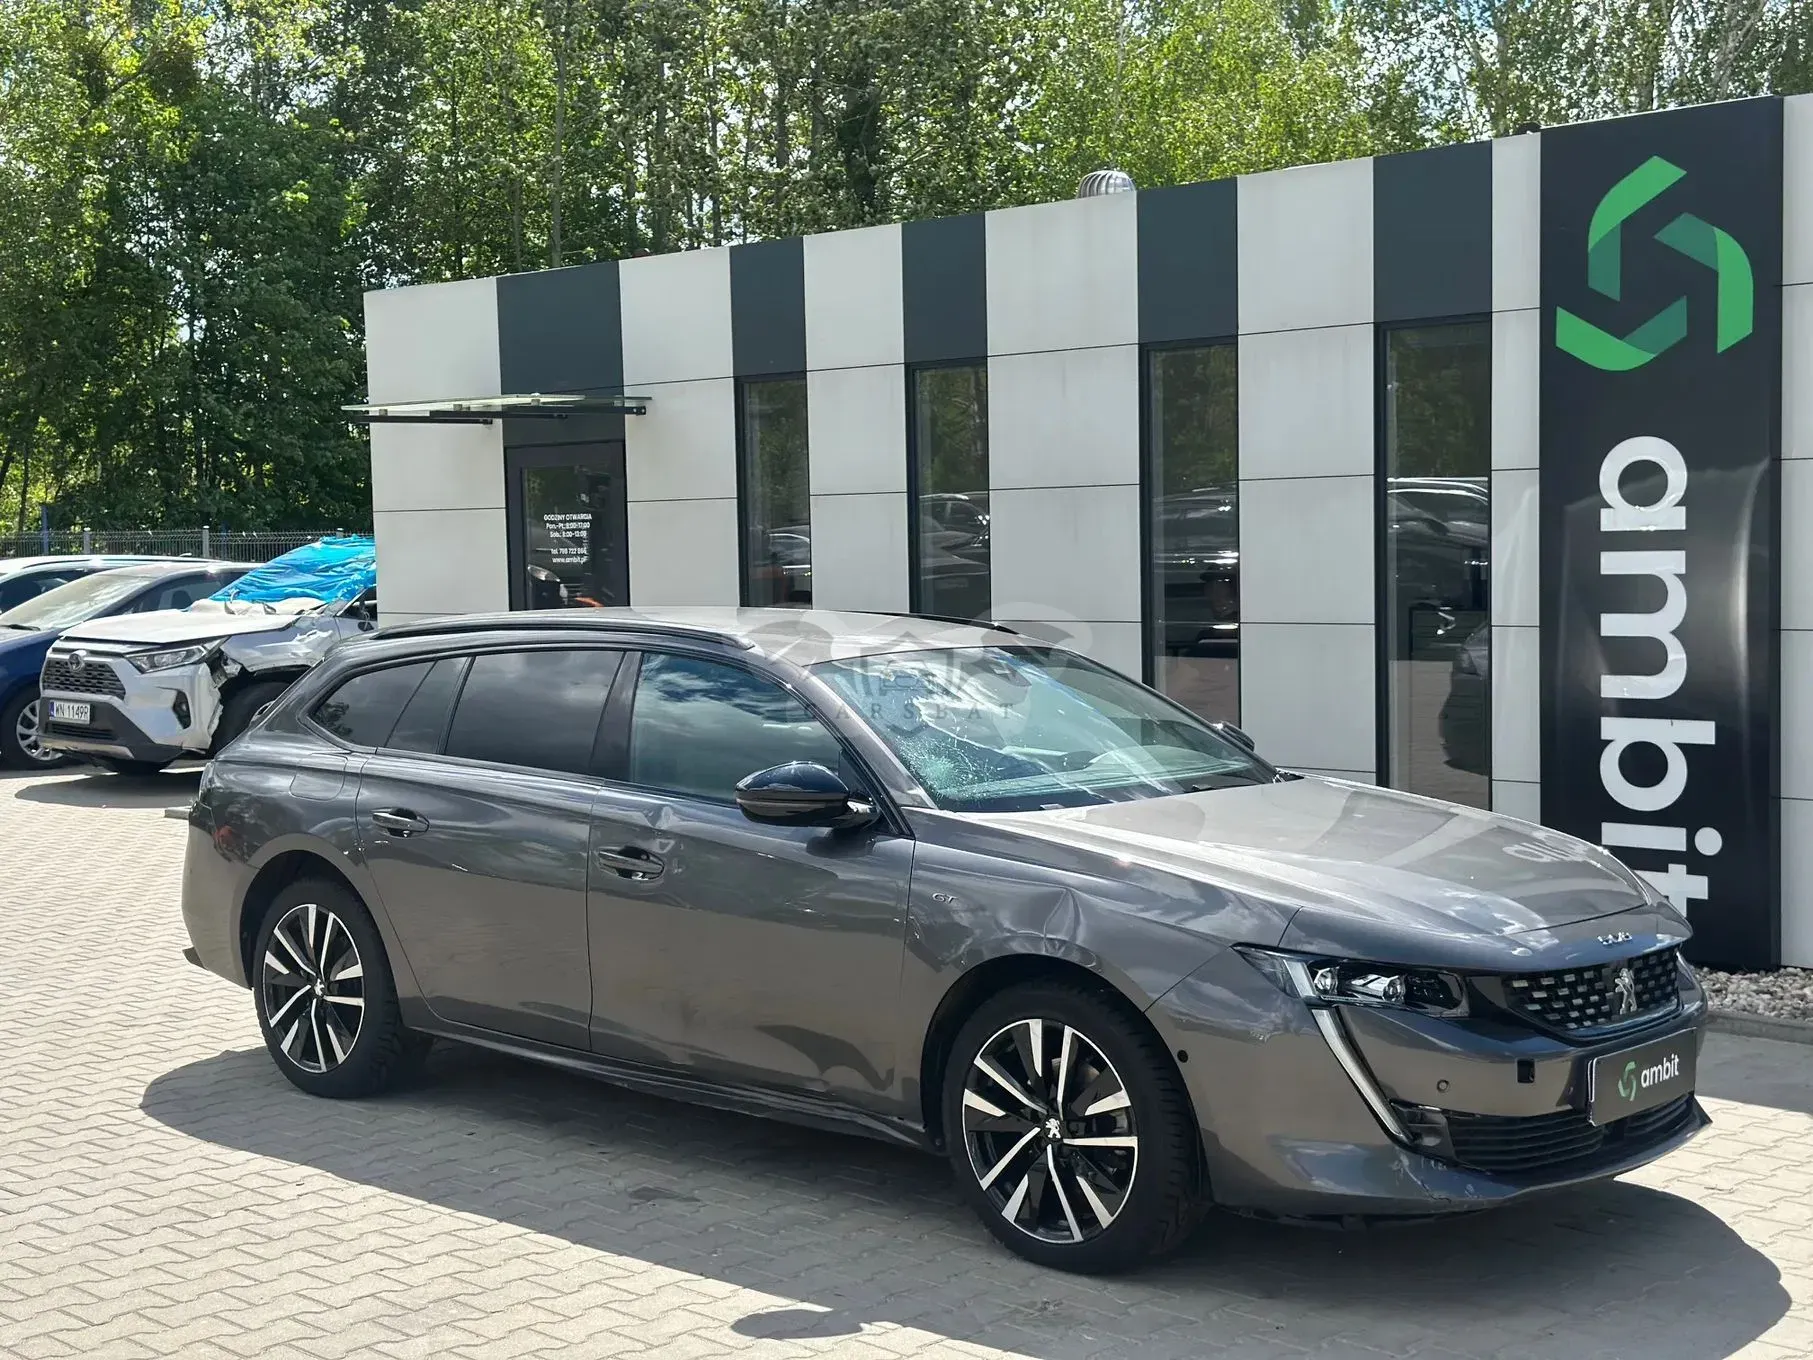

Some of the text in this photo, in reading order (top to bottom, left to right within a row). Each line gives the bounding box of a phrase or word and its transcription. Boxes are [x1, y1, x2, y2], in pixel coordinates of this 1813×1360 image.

[1599, 435, 1723, 919] ambit
[56, 704, 65, 717] WN
[932, 892, 959, 904] GT
[1640, 1052, 1681, 1089] ambit
